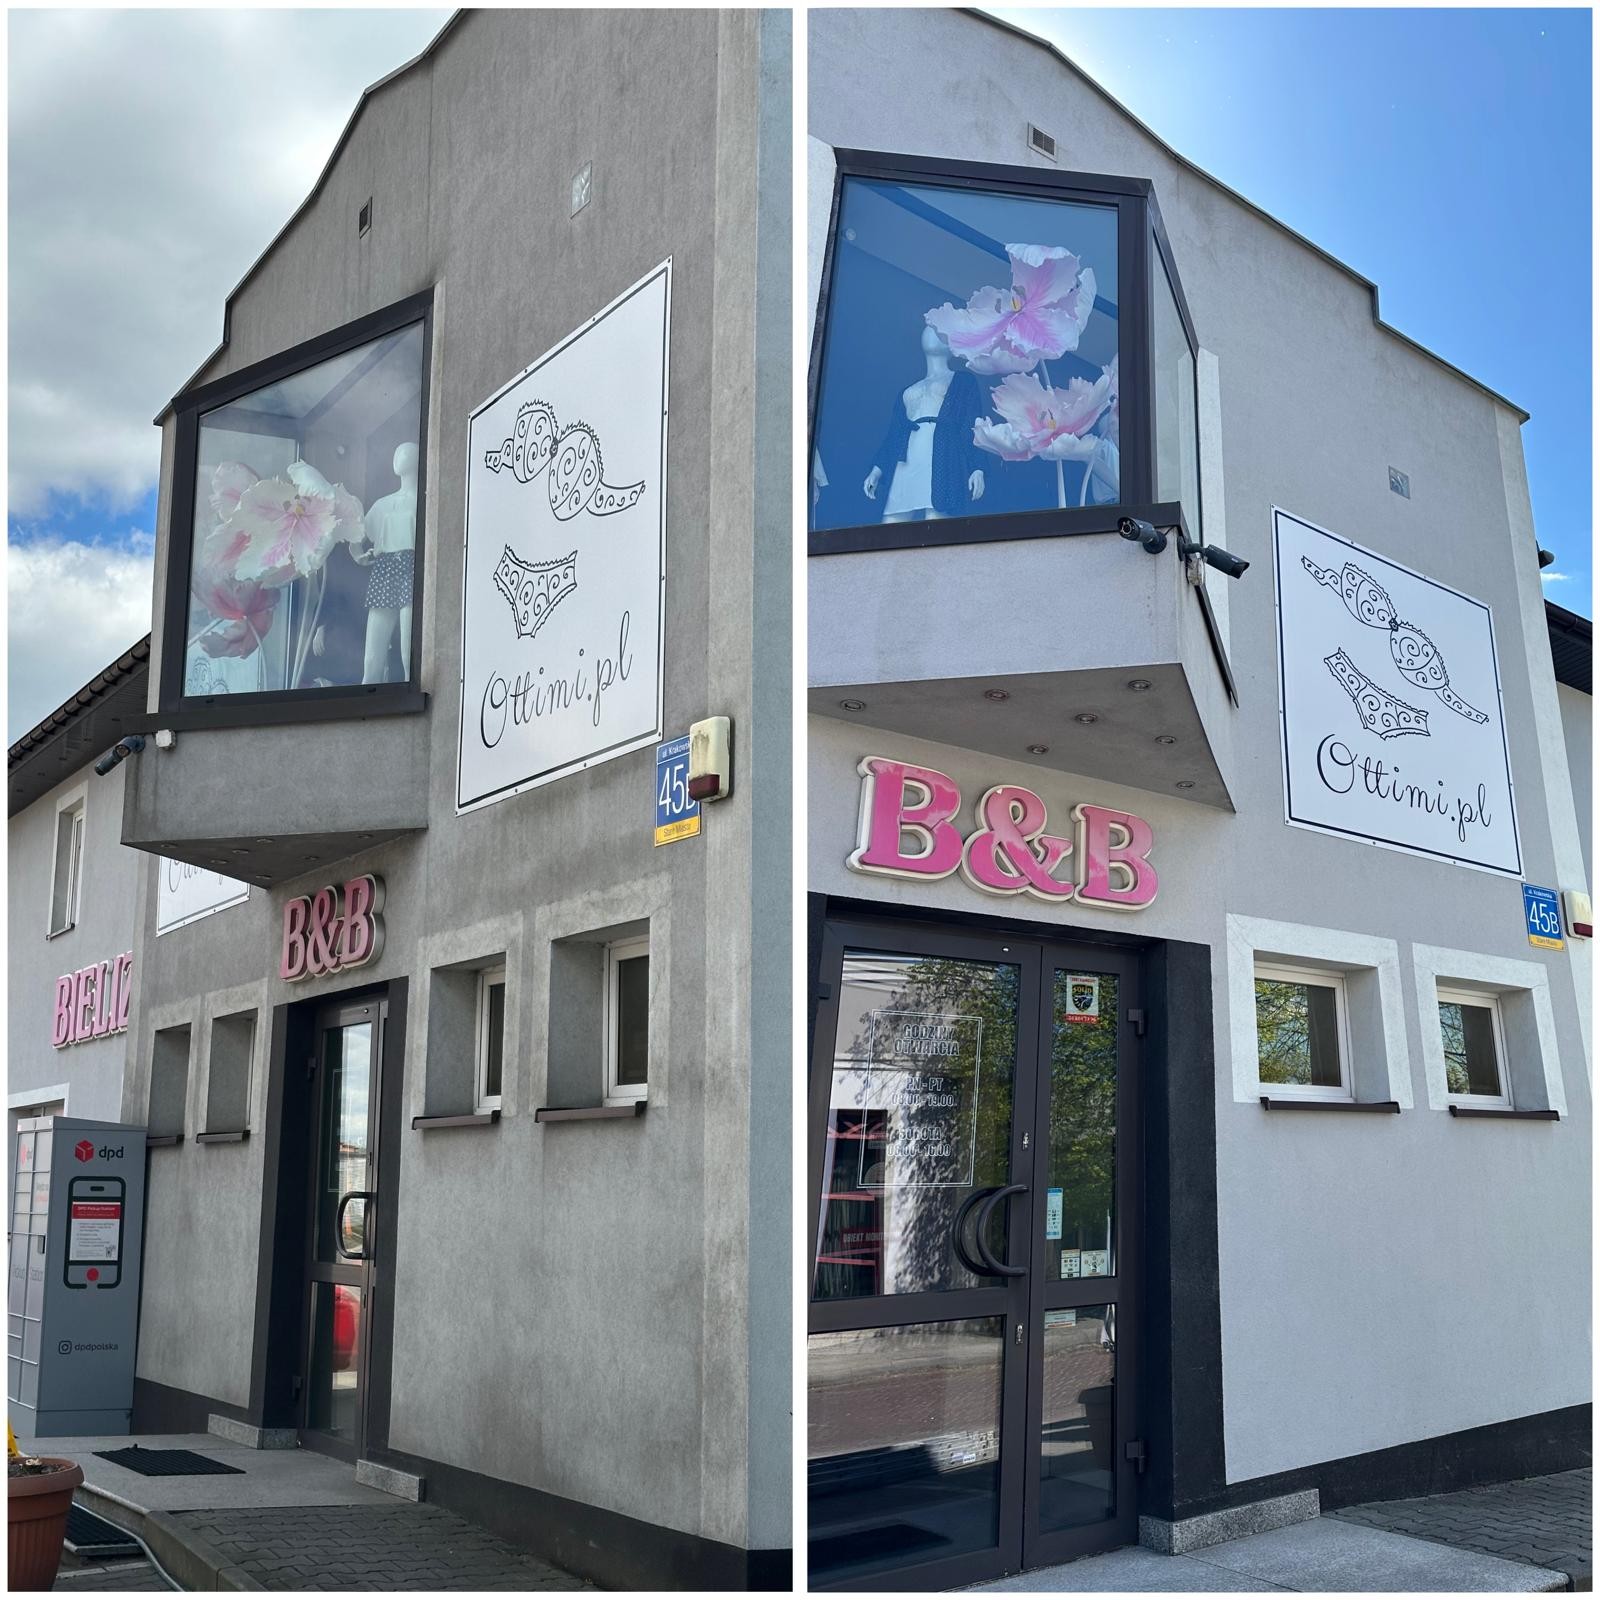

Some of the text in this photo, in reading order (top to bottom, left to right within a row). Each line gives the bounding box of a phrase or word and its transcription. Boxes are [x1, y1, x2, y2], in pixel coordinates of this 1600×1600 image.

[480, 610, 632, 748] Ottimi.pl
[1316, 733, 1491, 842] Ottimi.pl
[846, 756, 1159, 912] B&B
[279, 873, 383, 983] B&B
[1529, 900, 1560, 934] 45B
[894, 1037, 960, 1056] OTWARCIA
[903, 1024, 956, 1041] GODZINY
[98, 1145, 125, 1161] dpd
[74, 1343, 119, 1352] dpdpolska
